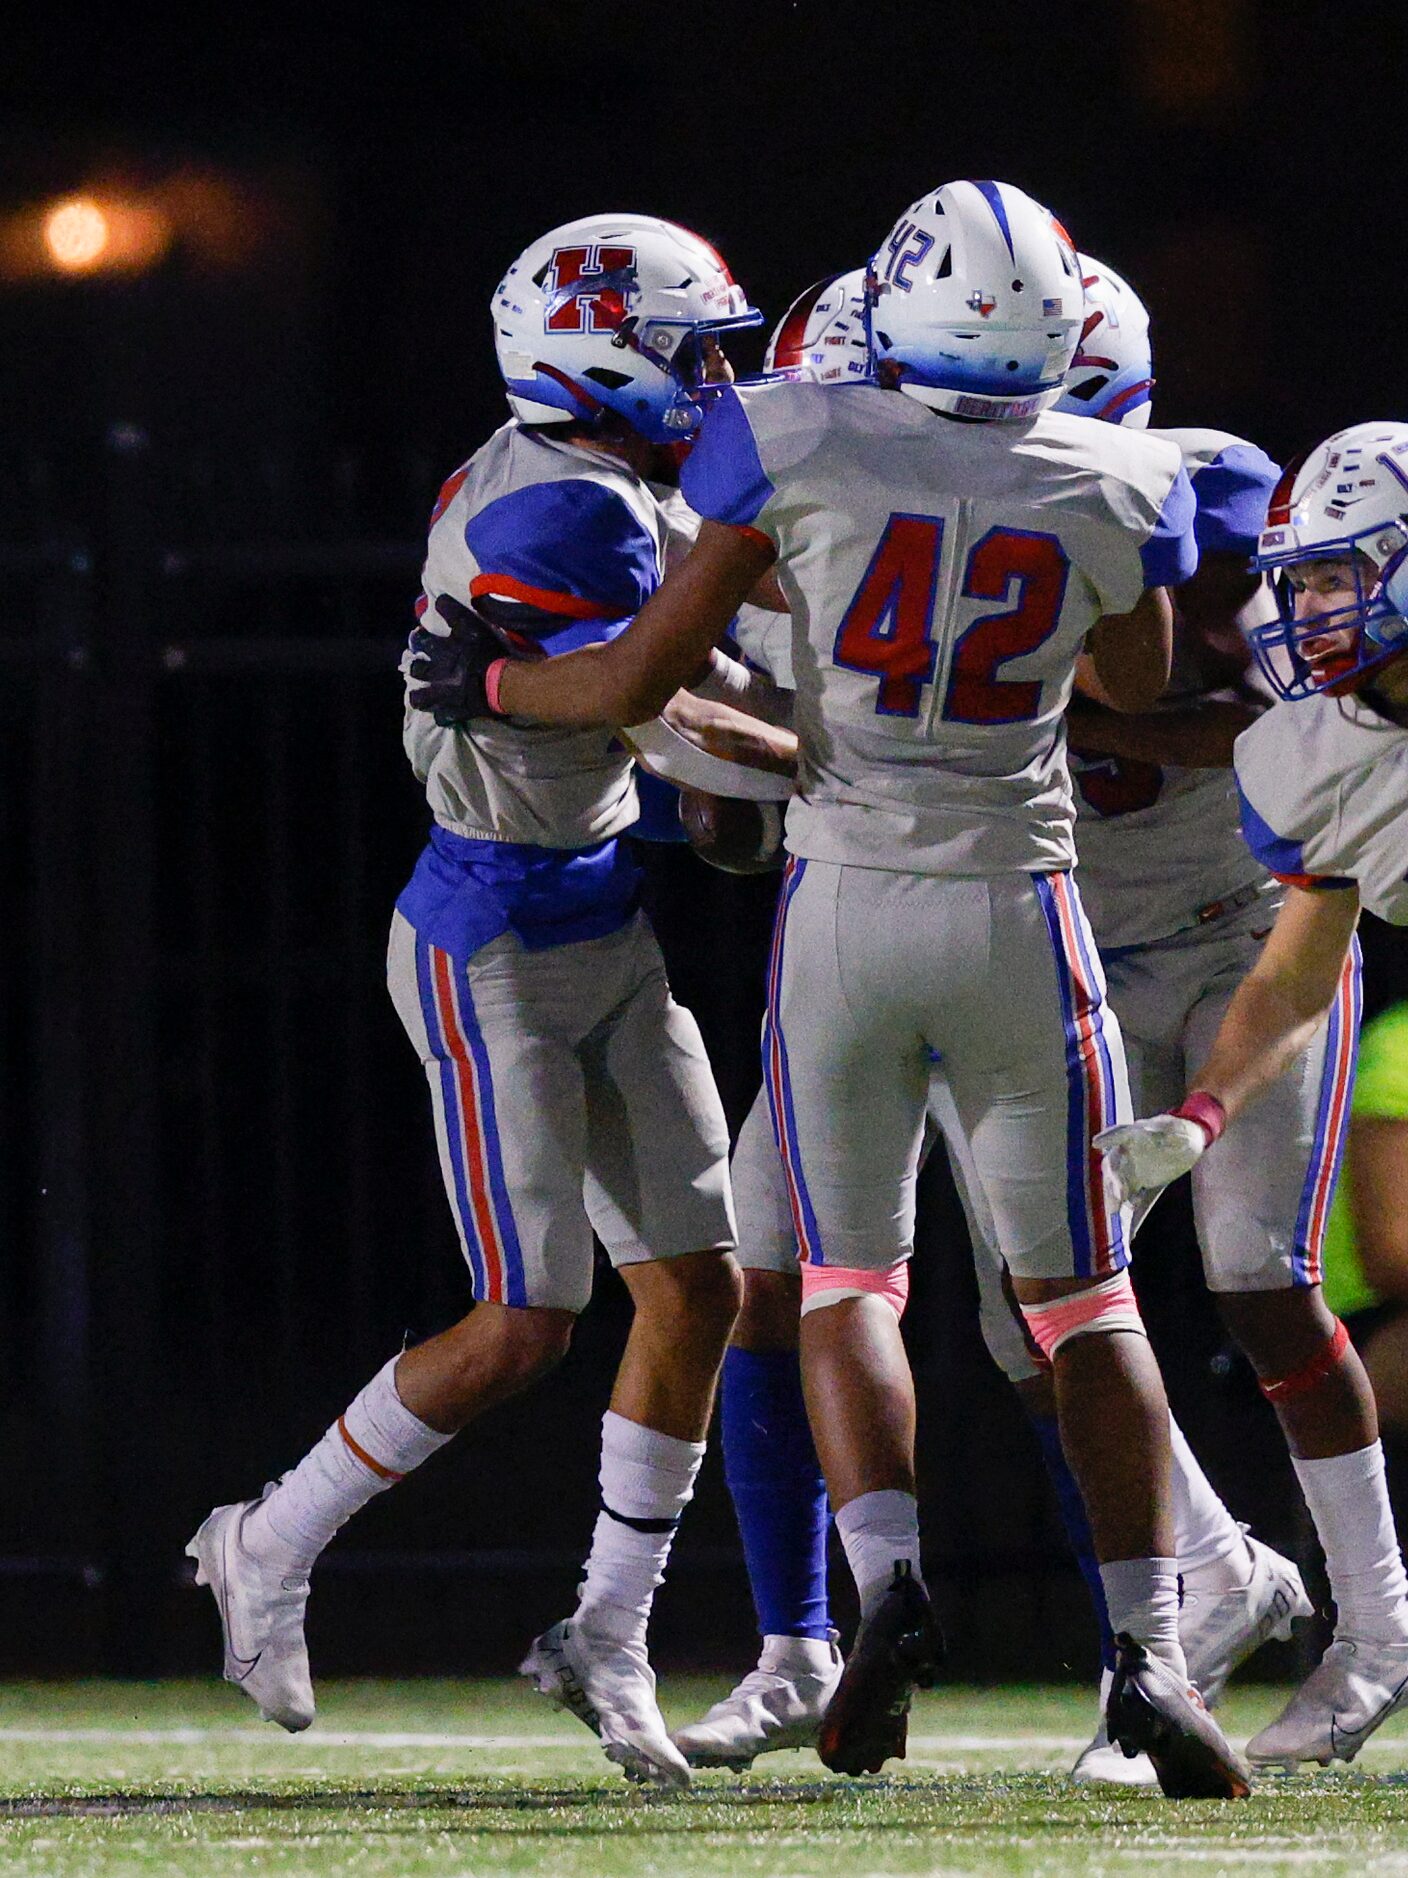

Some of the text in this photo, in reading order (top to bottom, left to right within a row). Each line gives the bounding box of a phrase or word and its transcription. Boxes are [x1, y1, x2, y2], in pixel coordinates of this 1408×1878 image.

[544, 244, 640, 335] H
[885, 219, 936, 294] 42
[832, 511, 1072, 727] 42
